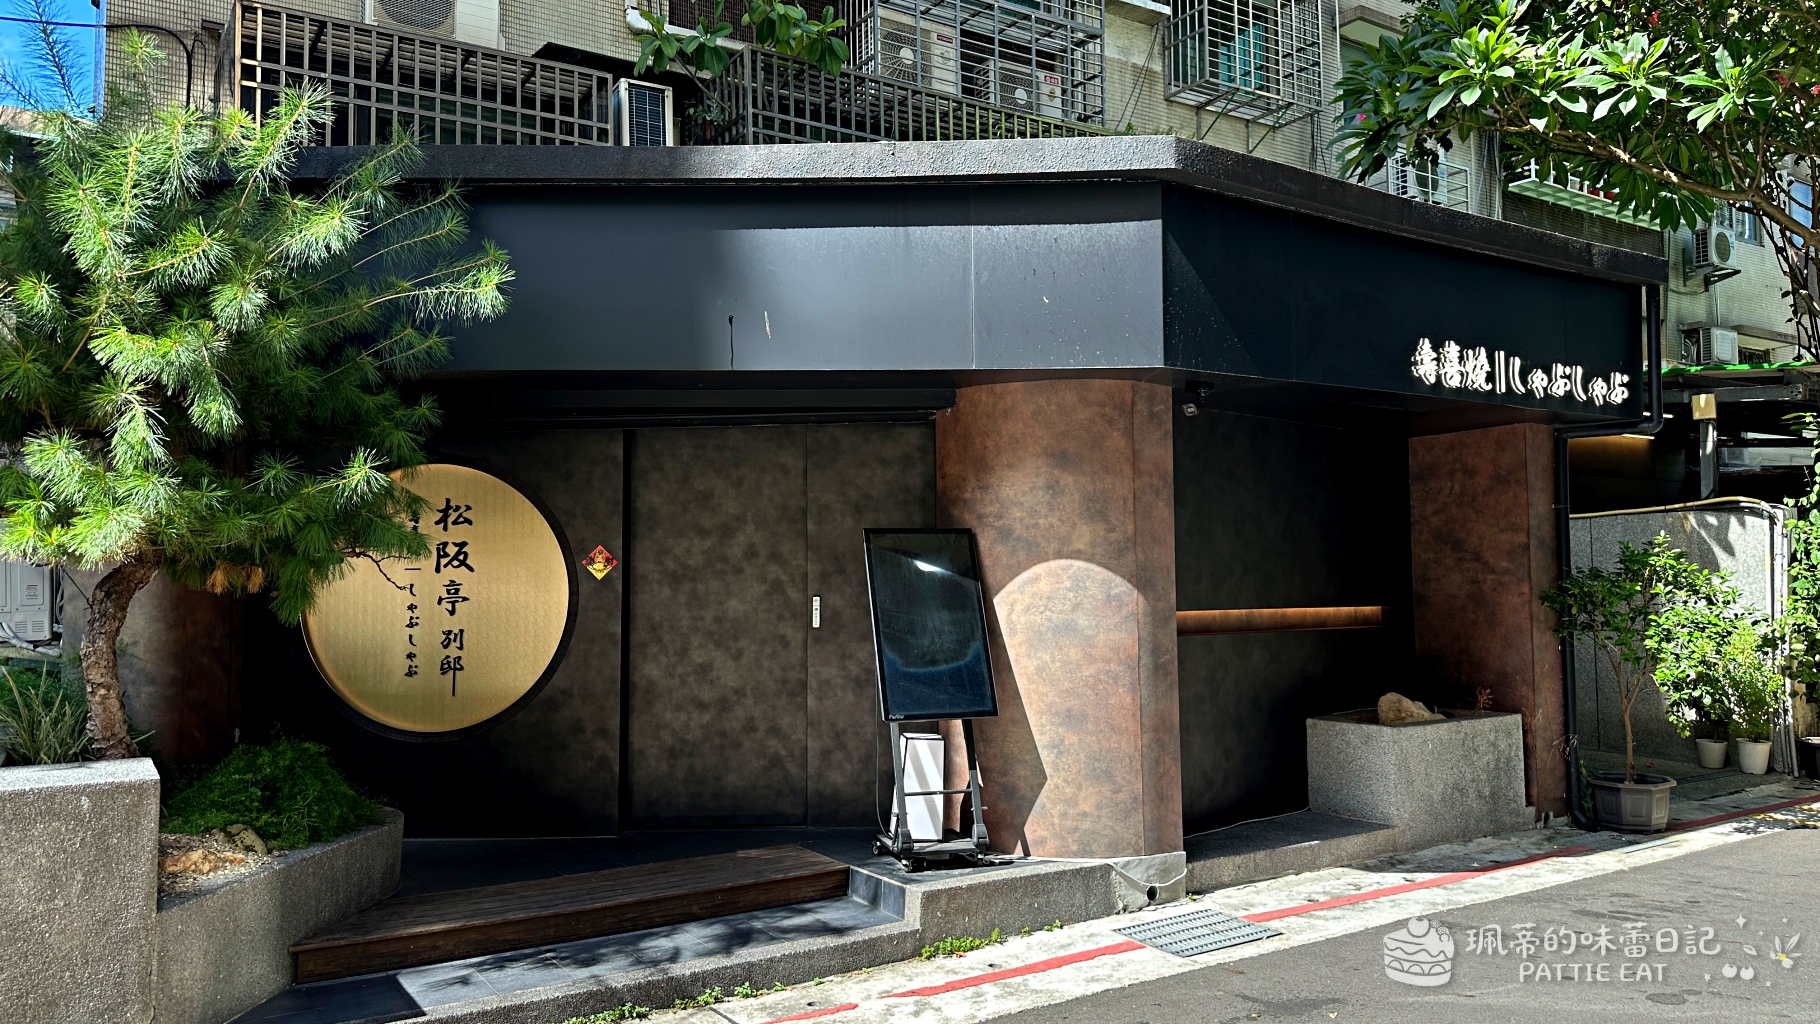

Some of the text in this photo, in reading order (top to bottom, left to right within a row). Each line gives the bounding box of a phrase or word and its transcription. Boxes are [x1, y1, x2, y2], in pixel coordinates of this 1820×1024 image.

[434, 498, 475, 697] 松阪亭別邸
